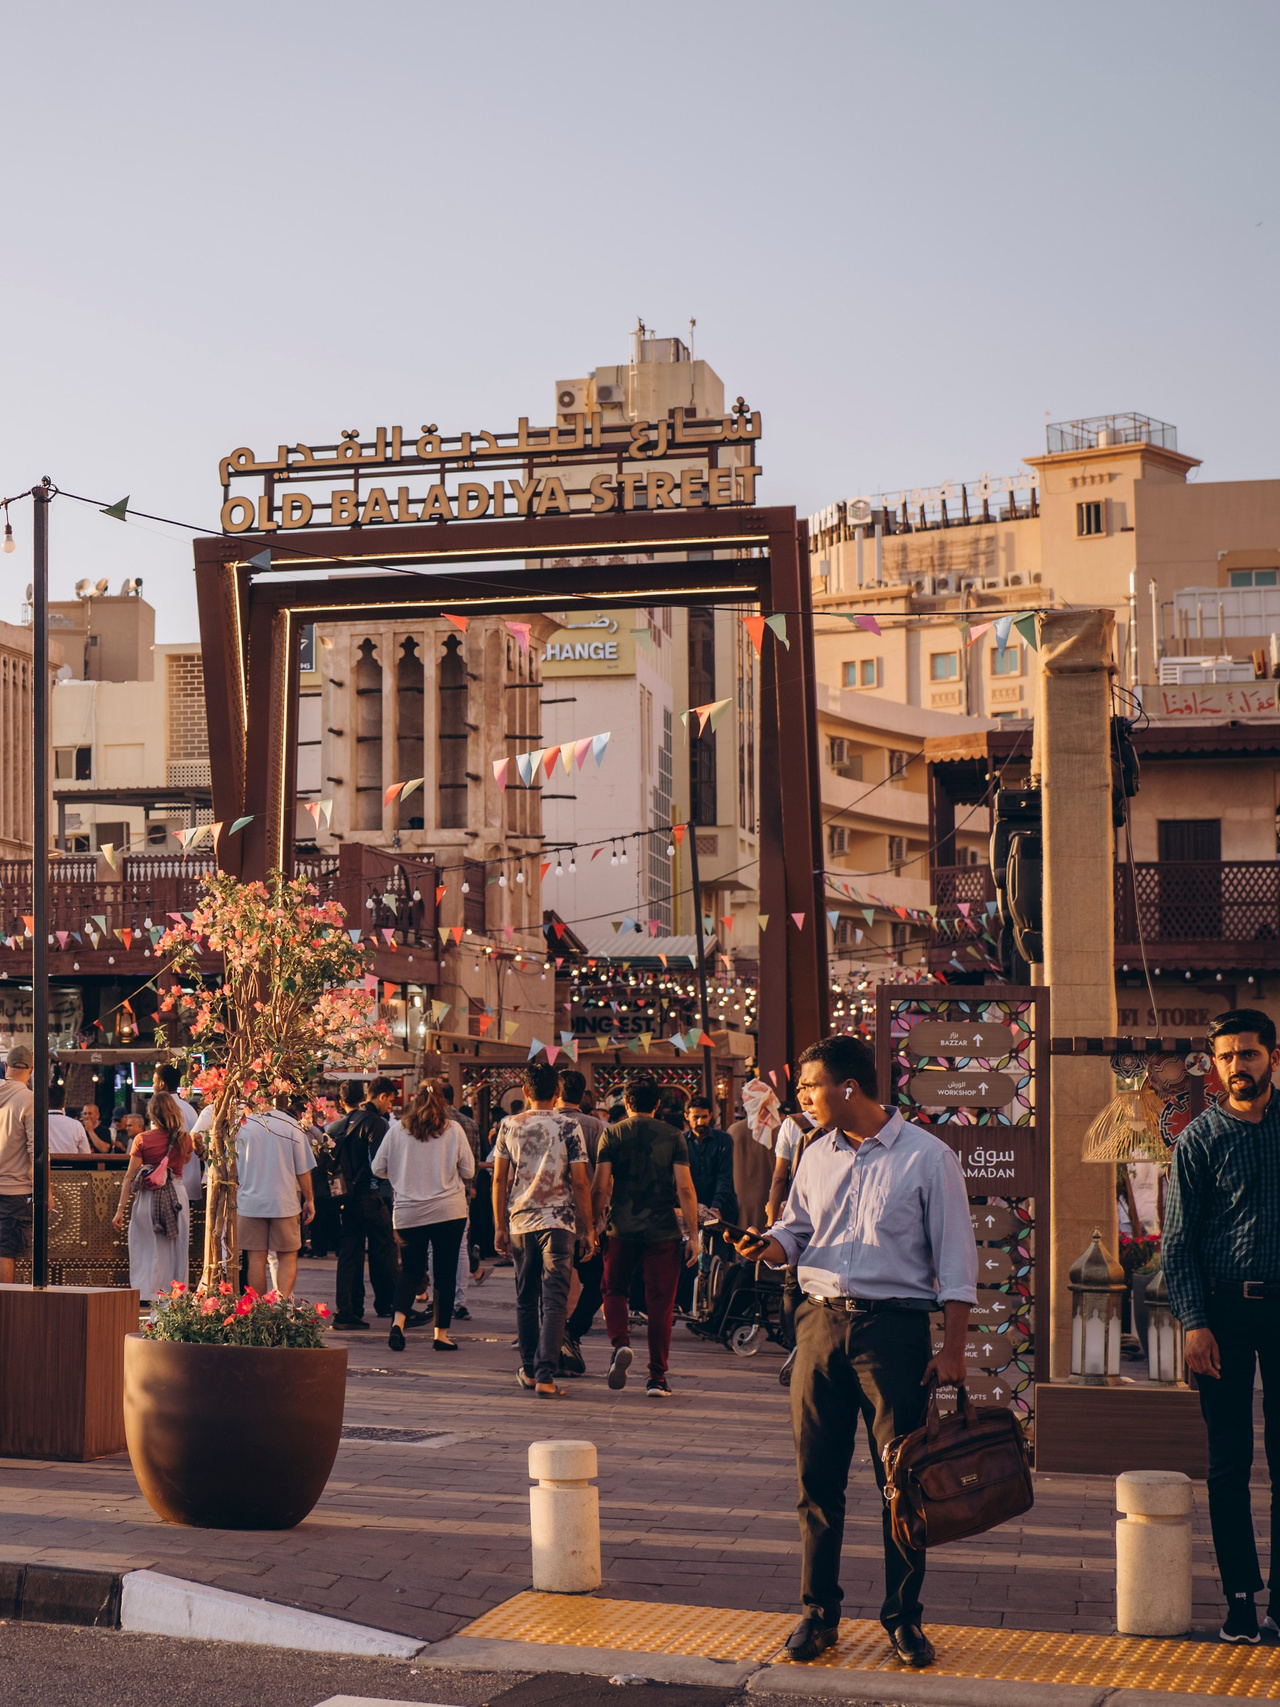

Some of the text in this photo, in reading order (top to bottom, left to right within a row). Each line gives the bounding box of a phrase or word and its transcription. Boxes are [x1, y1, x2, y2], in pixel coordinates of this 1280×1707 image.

[219, 396, 762, 486] شارع البلدية القديم
[220, 466, 763, 533] OLD BALADIYA STREET
[541, 641, 618, 661] HANGE
[1118, 1008, 1209, 1026] FI STORE
[968, 1146, 1014, 1166] سوق
